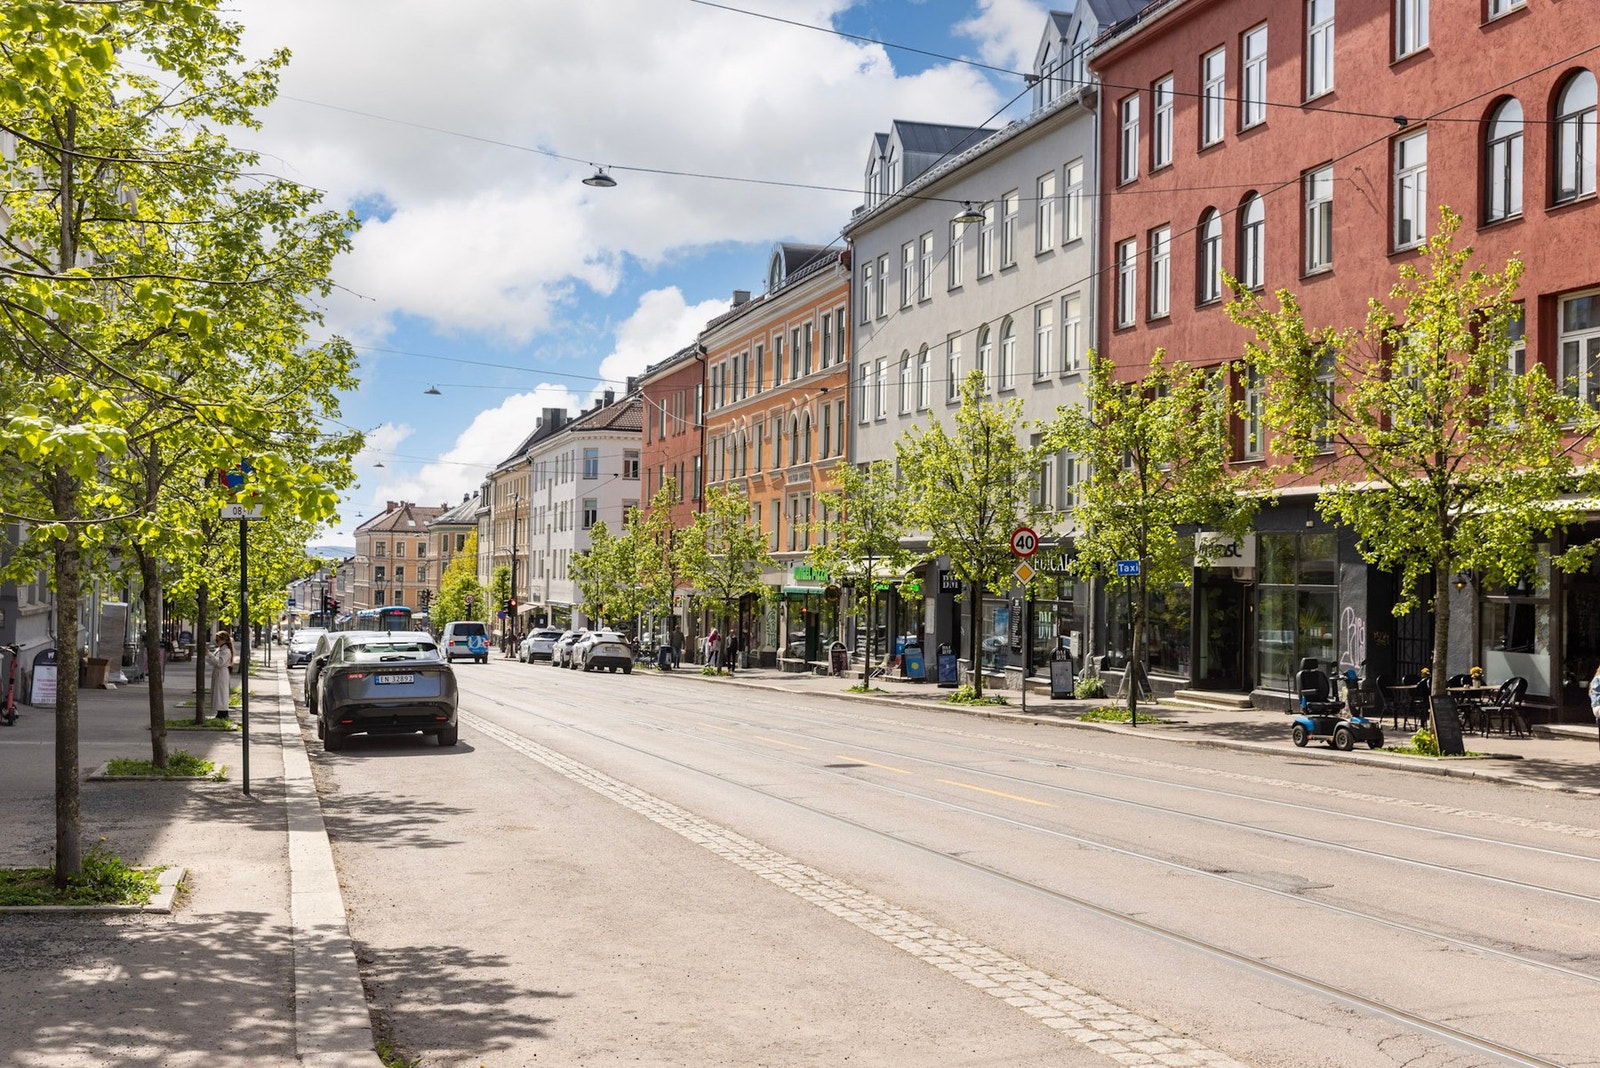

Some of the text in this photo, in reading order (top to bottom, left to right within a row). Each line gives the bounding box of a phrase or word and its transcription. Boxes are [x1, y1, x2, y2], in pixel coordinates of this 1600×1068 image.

[1016, 535, 1034, 550] 40
[1118, 563, 1139, 573] Taxi
[381, 674, 413, 683] EN 32892
